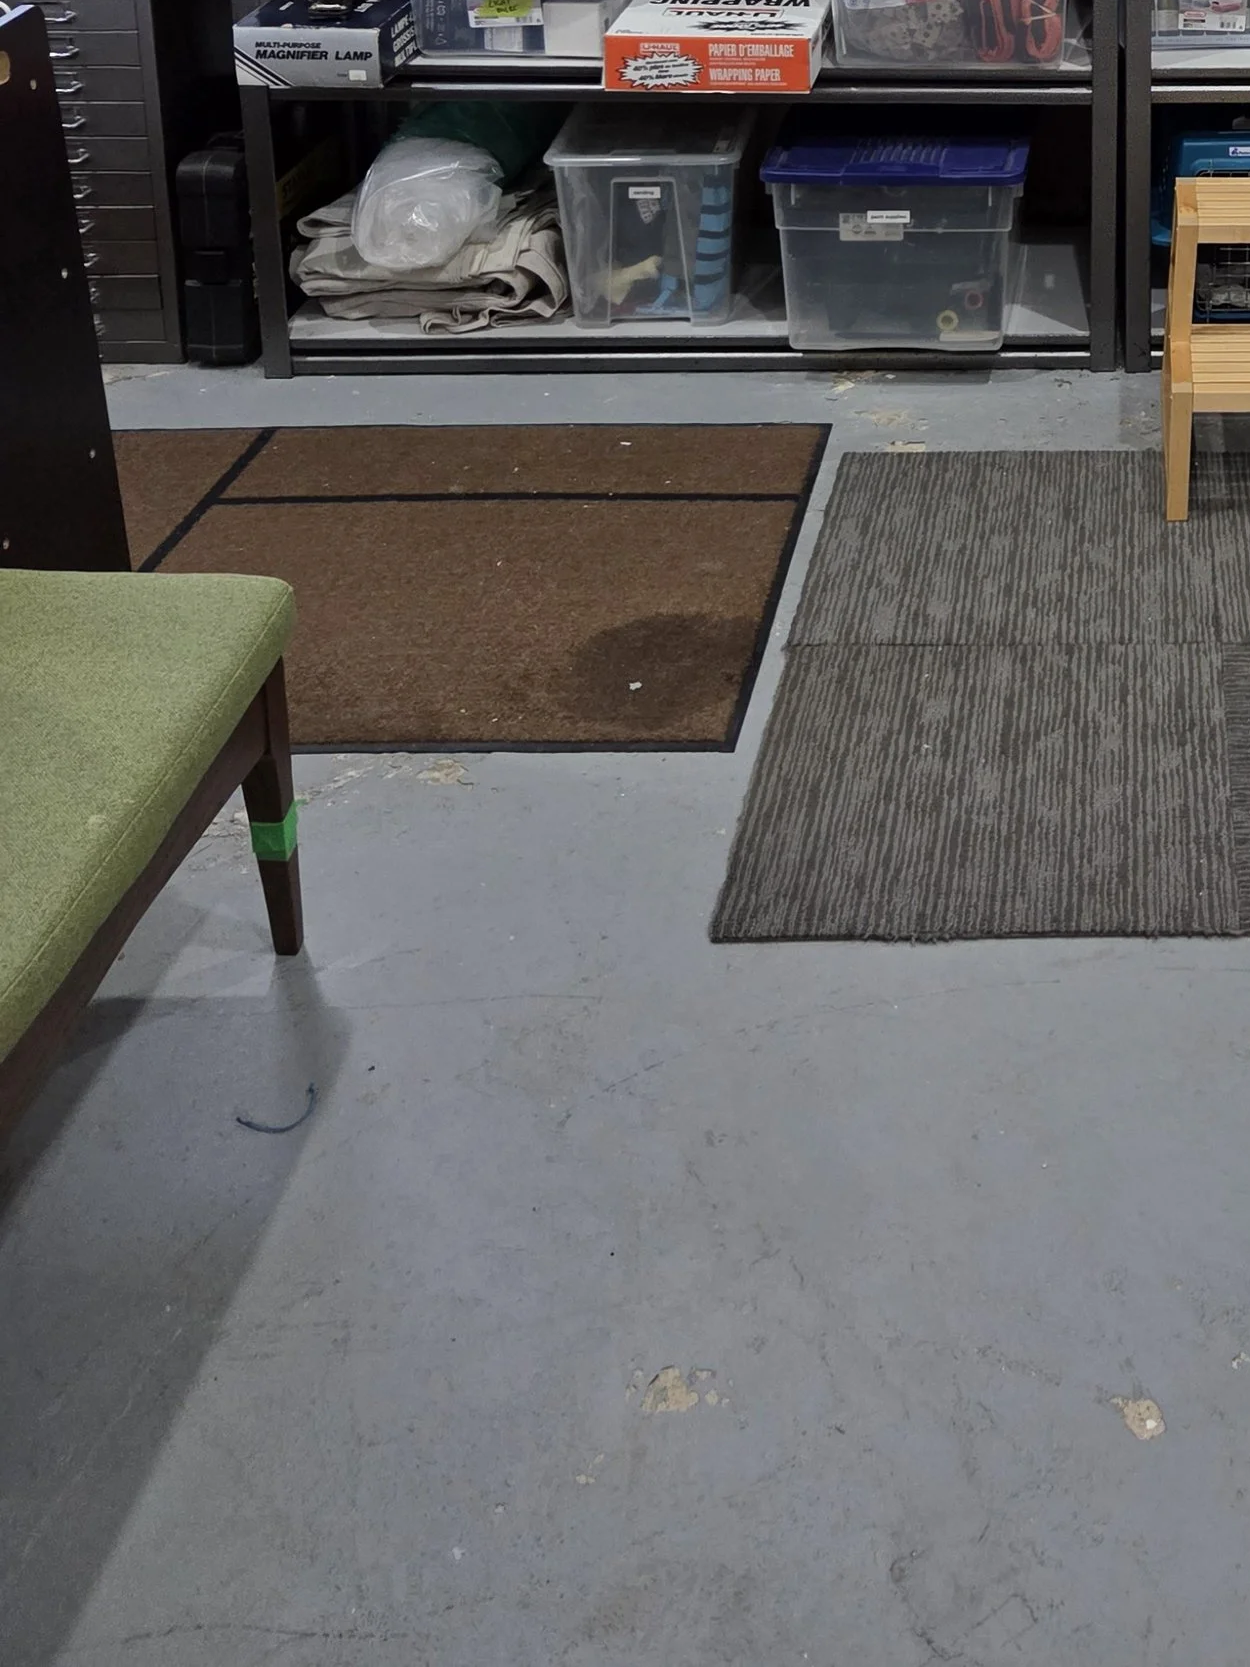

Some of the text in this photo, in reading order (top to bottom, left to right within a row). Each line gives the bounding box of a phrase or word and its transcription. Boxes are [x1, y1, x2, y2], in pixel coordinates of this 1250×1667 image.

[668, 10, 777, 19] U-HAUL
[255, 41, 321, 49] MULTI-PURPOSE
[708, 43, 794, 58] PAPIER D'EMBALLAGE
[255, 49, 373, 61] MAGNIFIER LAMP
[709, 68, 781, 82] WRAPPING PAPER
